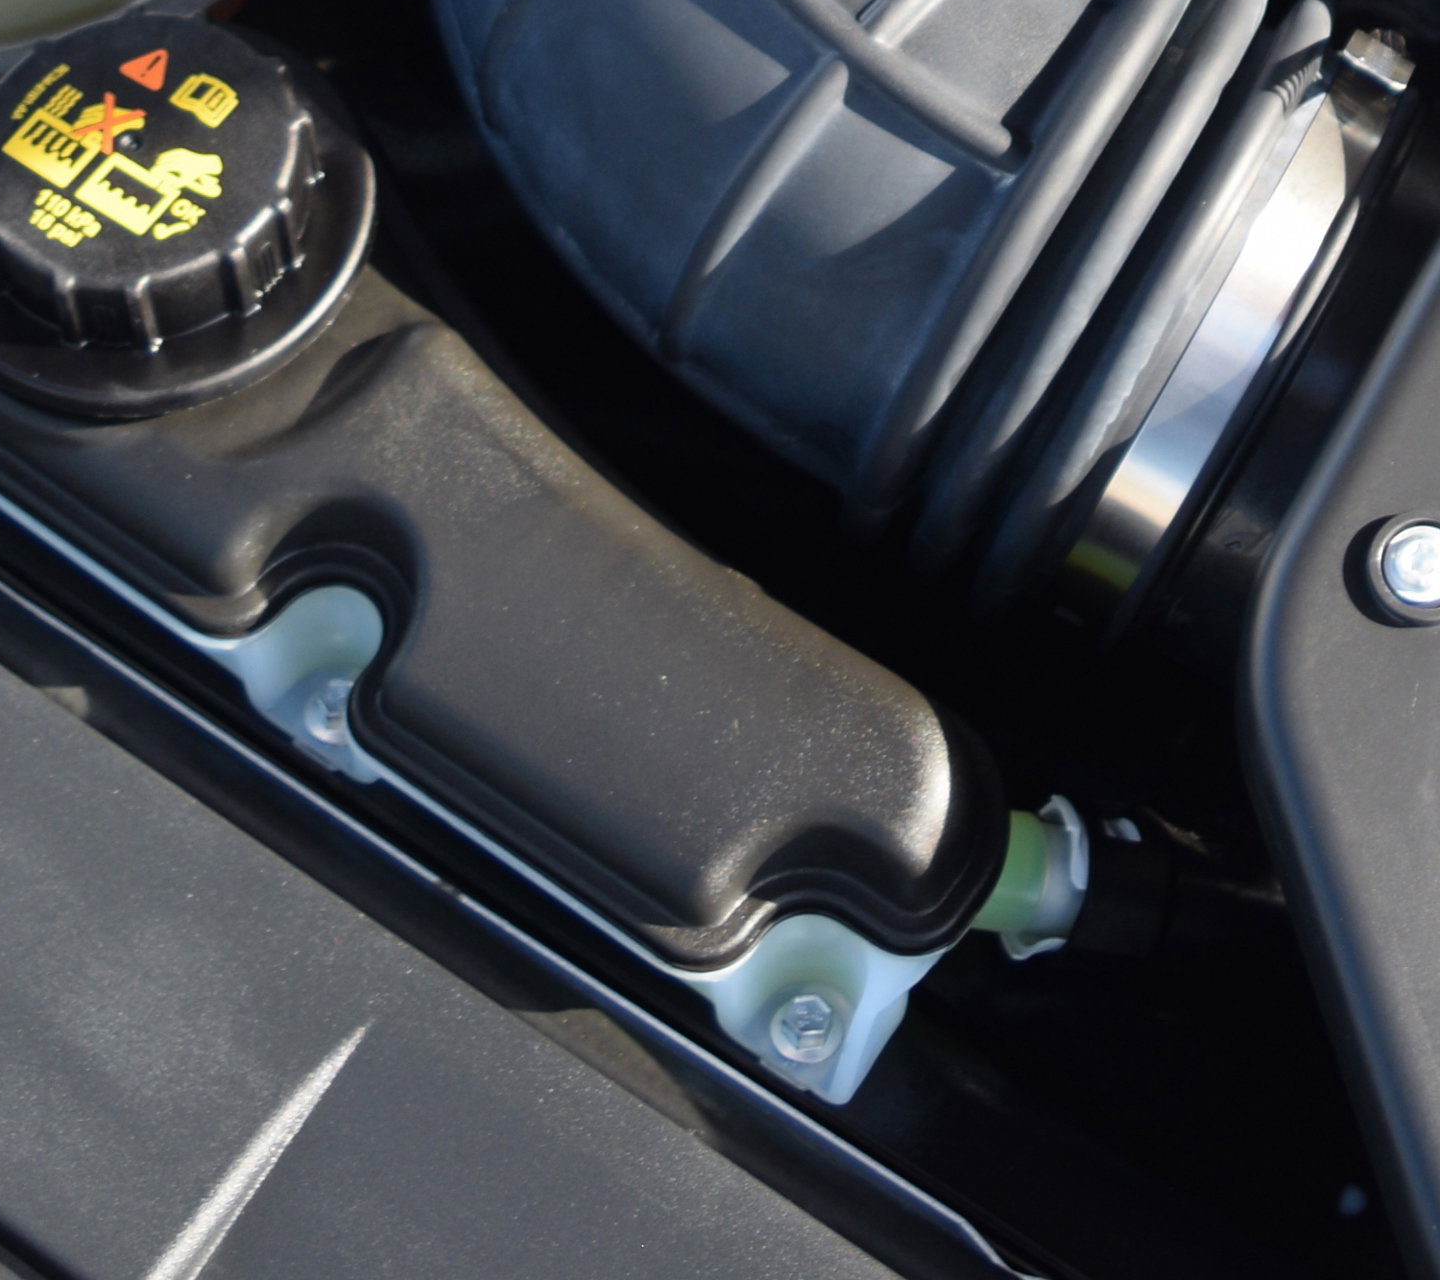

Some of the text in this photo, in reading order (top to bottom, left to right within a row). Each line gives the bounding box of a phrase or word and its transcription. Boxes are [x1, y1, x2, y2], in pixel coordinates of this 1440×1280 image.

[33, 188, 103, 239] 110 kPa
[170, 197, 207, 226] OK
[45, 222, 85, 249] psi
